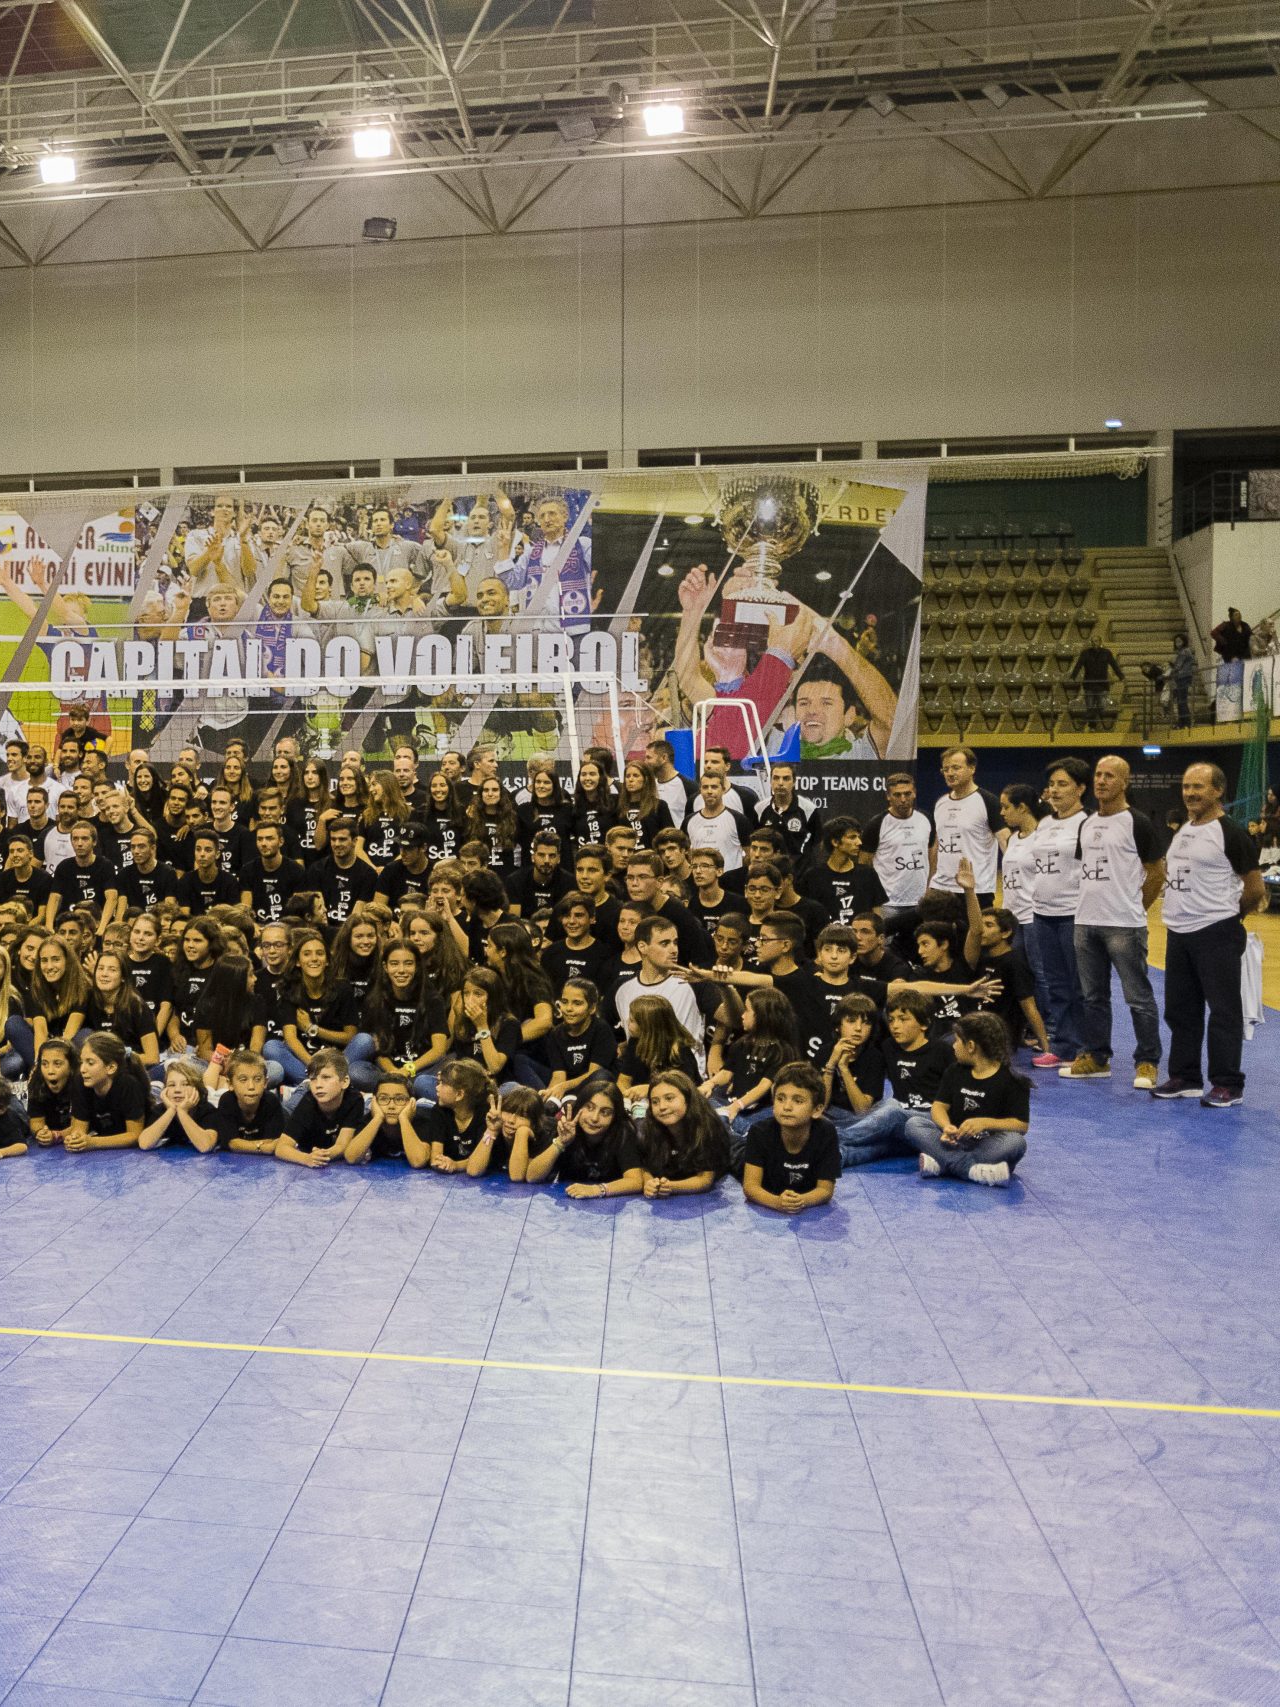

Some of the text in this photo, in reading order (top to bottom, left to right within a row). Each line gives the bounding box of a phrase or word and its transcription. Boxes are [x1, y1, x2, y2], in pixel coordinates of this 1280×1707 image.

[51, 631, 648, 700] CAPITAL DO VOLEIBOL
[794, 776, 819, 791] TOP
[822, 776, 869, 791] TEAMS
[306, 820, 317, 830] 10
[588, 821, 600, 831] 18
[630, 821, 642, 831] 18
[383, 828, 395, 838] 10
[442, 830, 455, 841] 10
[122, 851, 133, 861] 18
[222, 851, 232, 861] 19
[82, 888, 96, 899] 15
[269, 893, 282, 904] 10
[340, 891, 351, 902] 15
[146, 894, 157, 905] 16
[840, 896, 854, 909] 17
